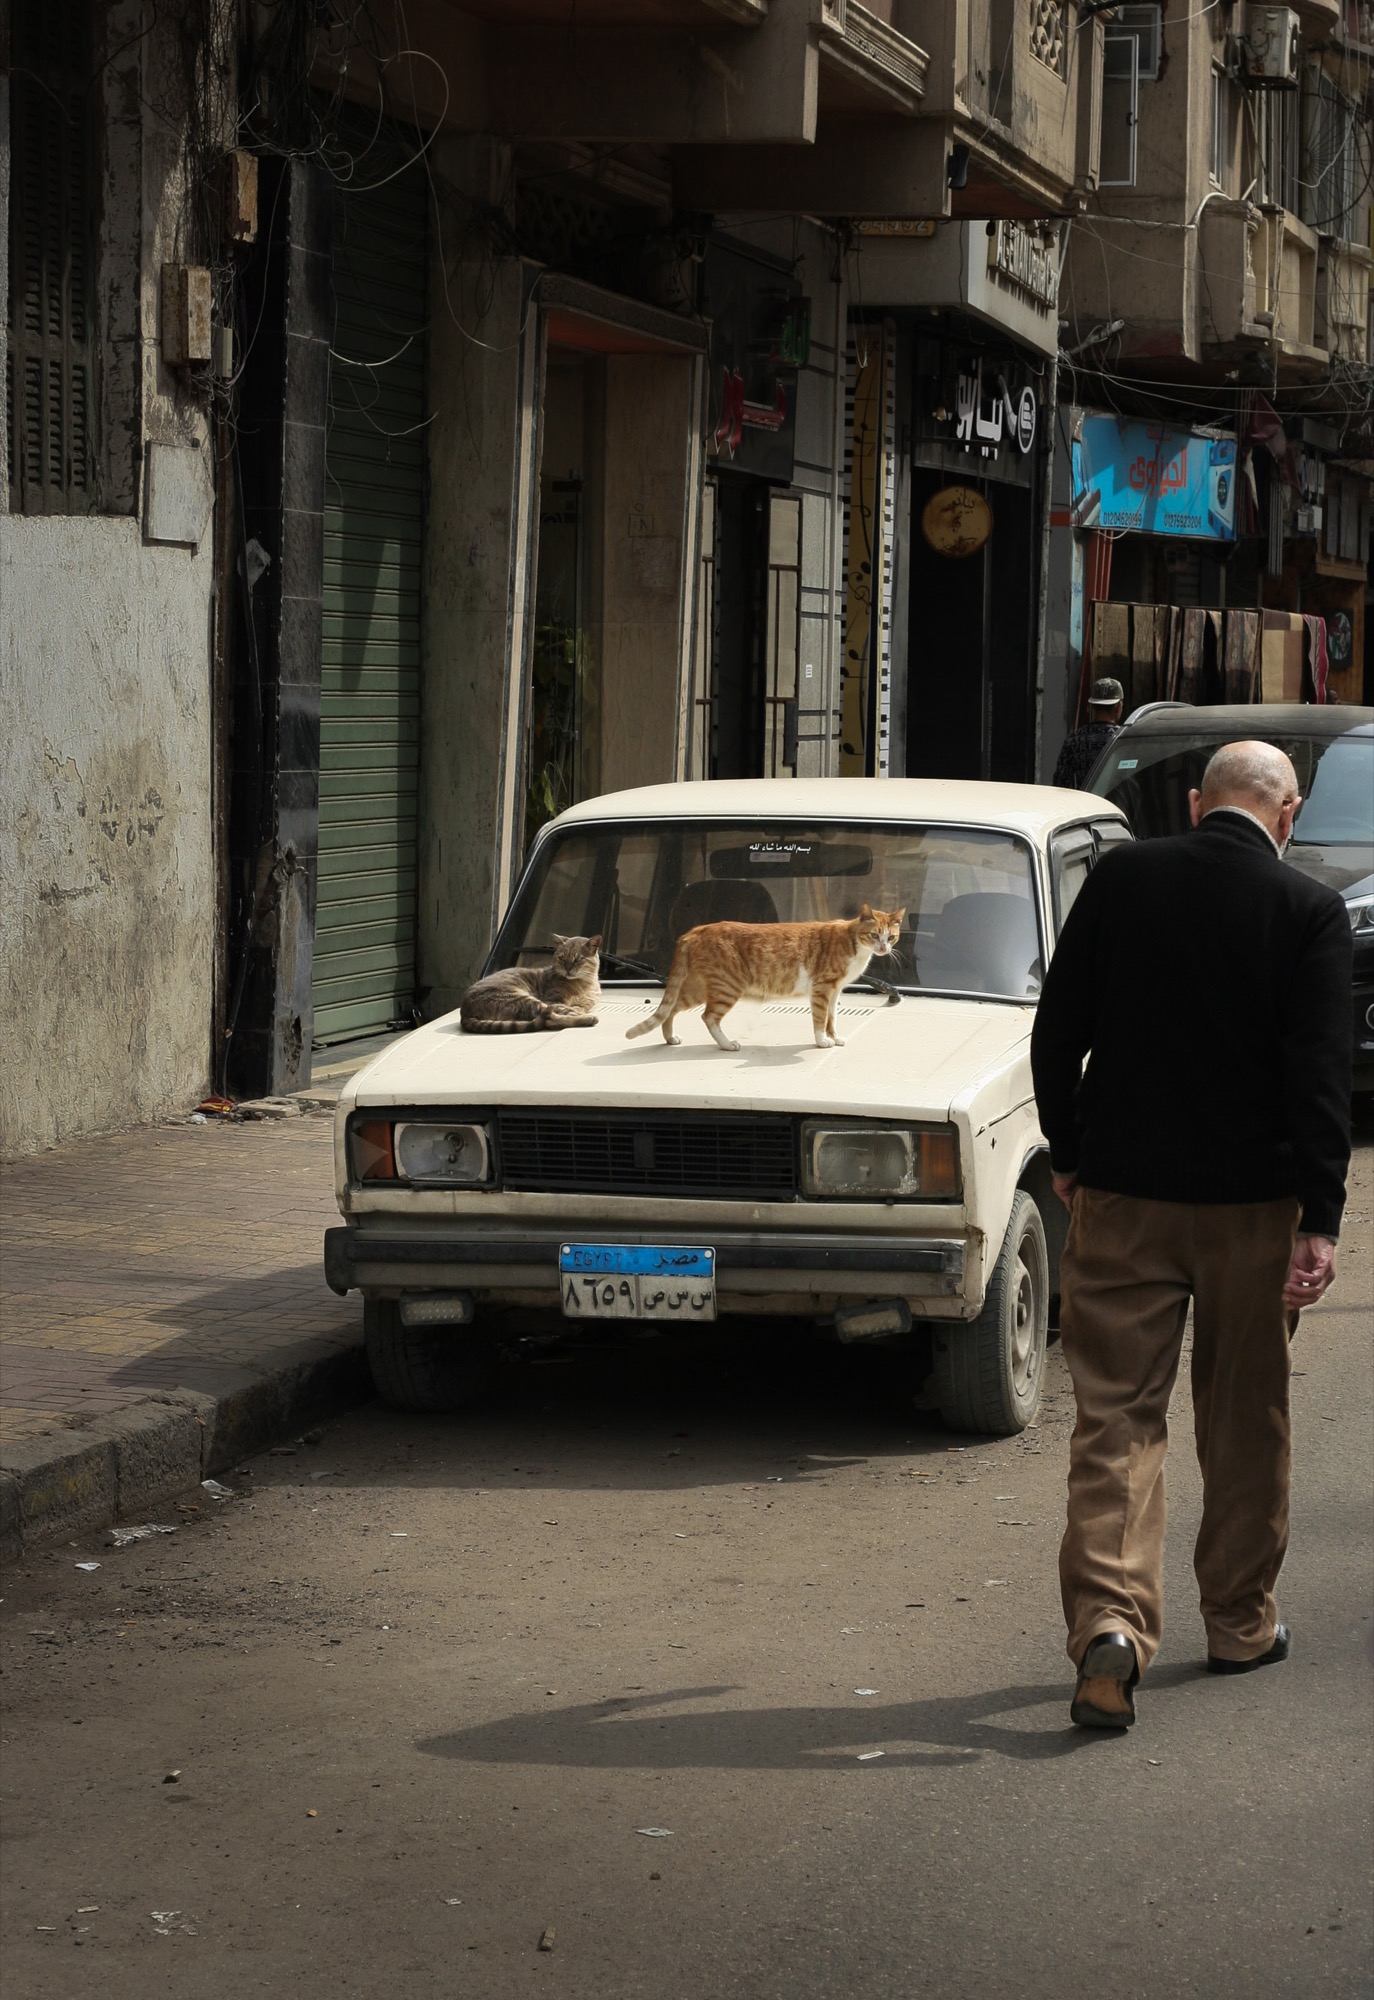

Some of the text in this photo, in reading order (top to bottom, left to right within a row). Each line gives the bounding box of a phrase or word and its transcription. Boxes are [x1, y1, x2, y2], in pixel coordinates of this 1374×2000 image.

[749, 842, 811, 854] بسم الله ما شاء لله
[574, 1251, 624, 1267] EGYPT
[653, 1253, 699, 1269] مصر
